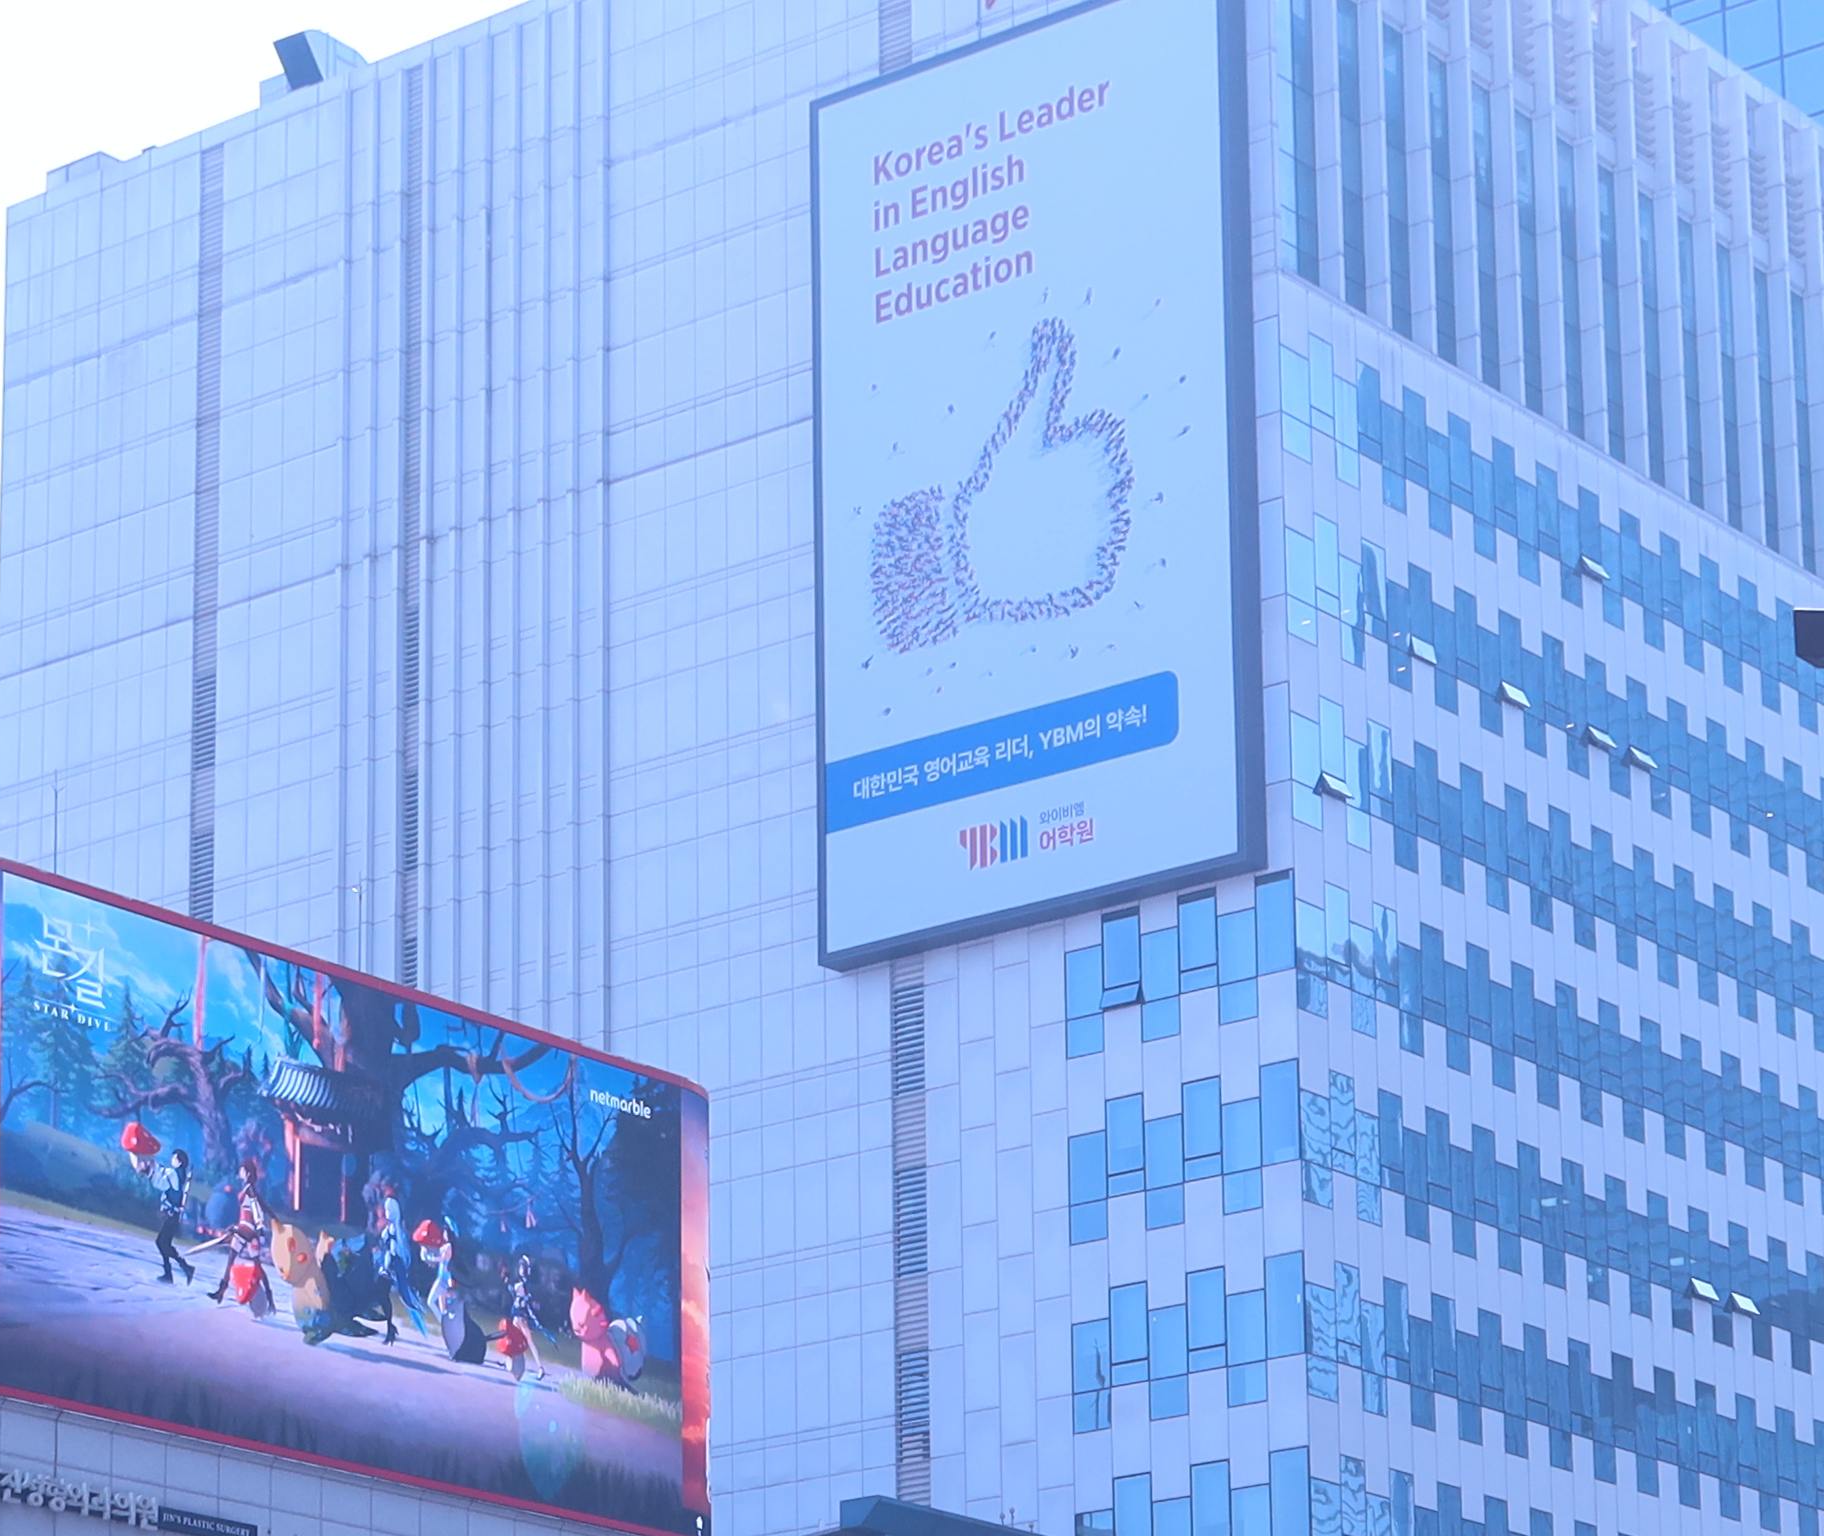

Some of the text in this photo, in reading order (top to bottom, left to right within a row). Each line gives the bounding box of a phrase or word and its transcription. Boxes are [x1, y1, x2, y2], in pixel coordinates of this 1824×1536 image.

[873, 80, 1110, 186] Korea's Leader
[873, 153, 1025, 232] in English
[874, 205, 1030, 278] Language
[874, 250, 1034, 324] Education
[853, 703, 1148, 800] 대한민국 영어교육 리더, YBM의 약속!
[1038, 818, 1095, 852] 어학원
[1039, 800, 1086, 825] 와이비엠
[33, 1001, 70, 1020] STAR
[589, 1087, 652, 1119] netmarble
[182, 1515, 216, 1531] PLASTIC
